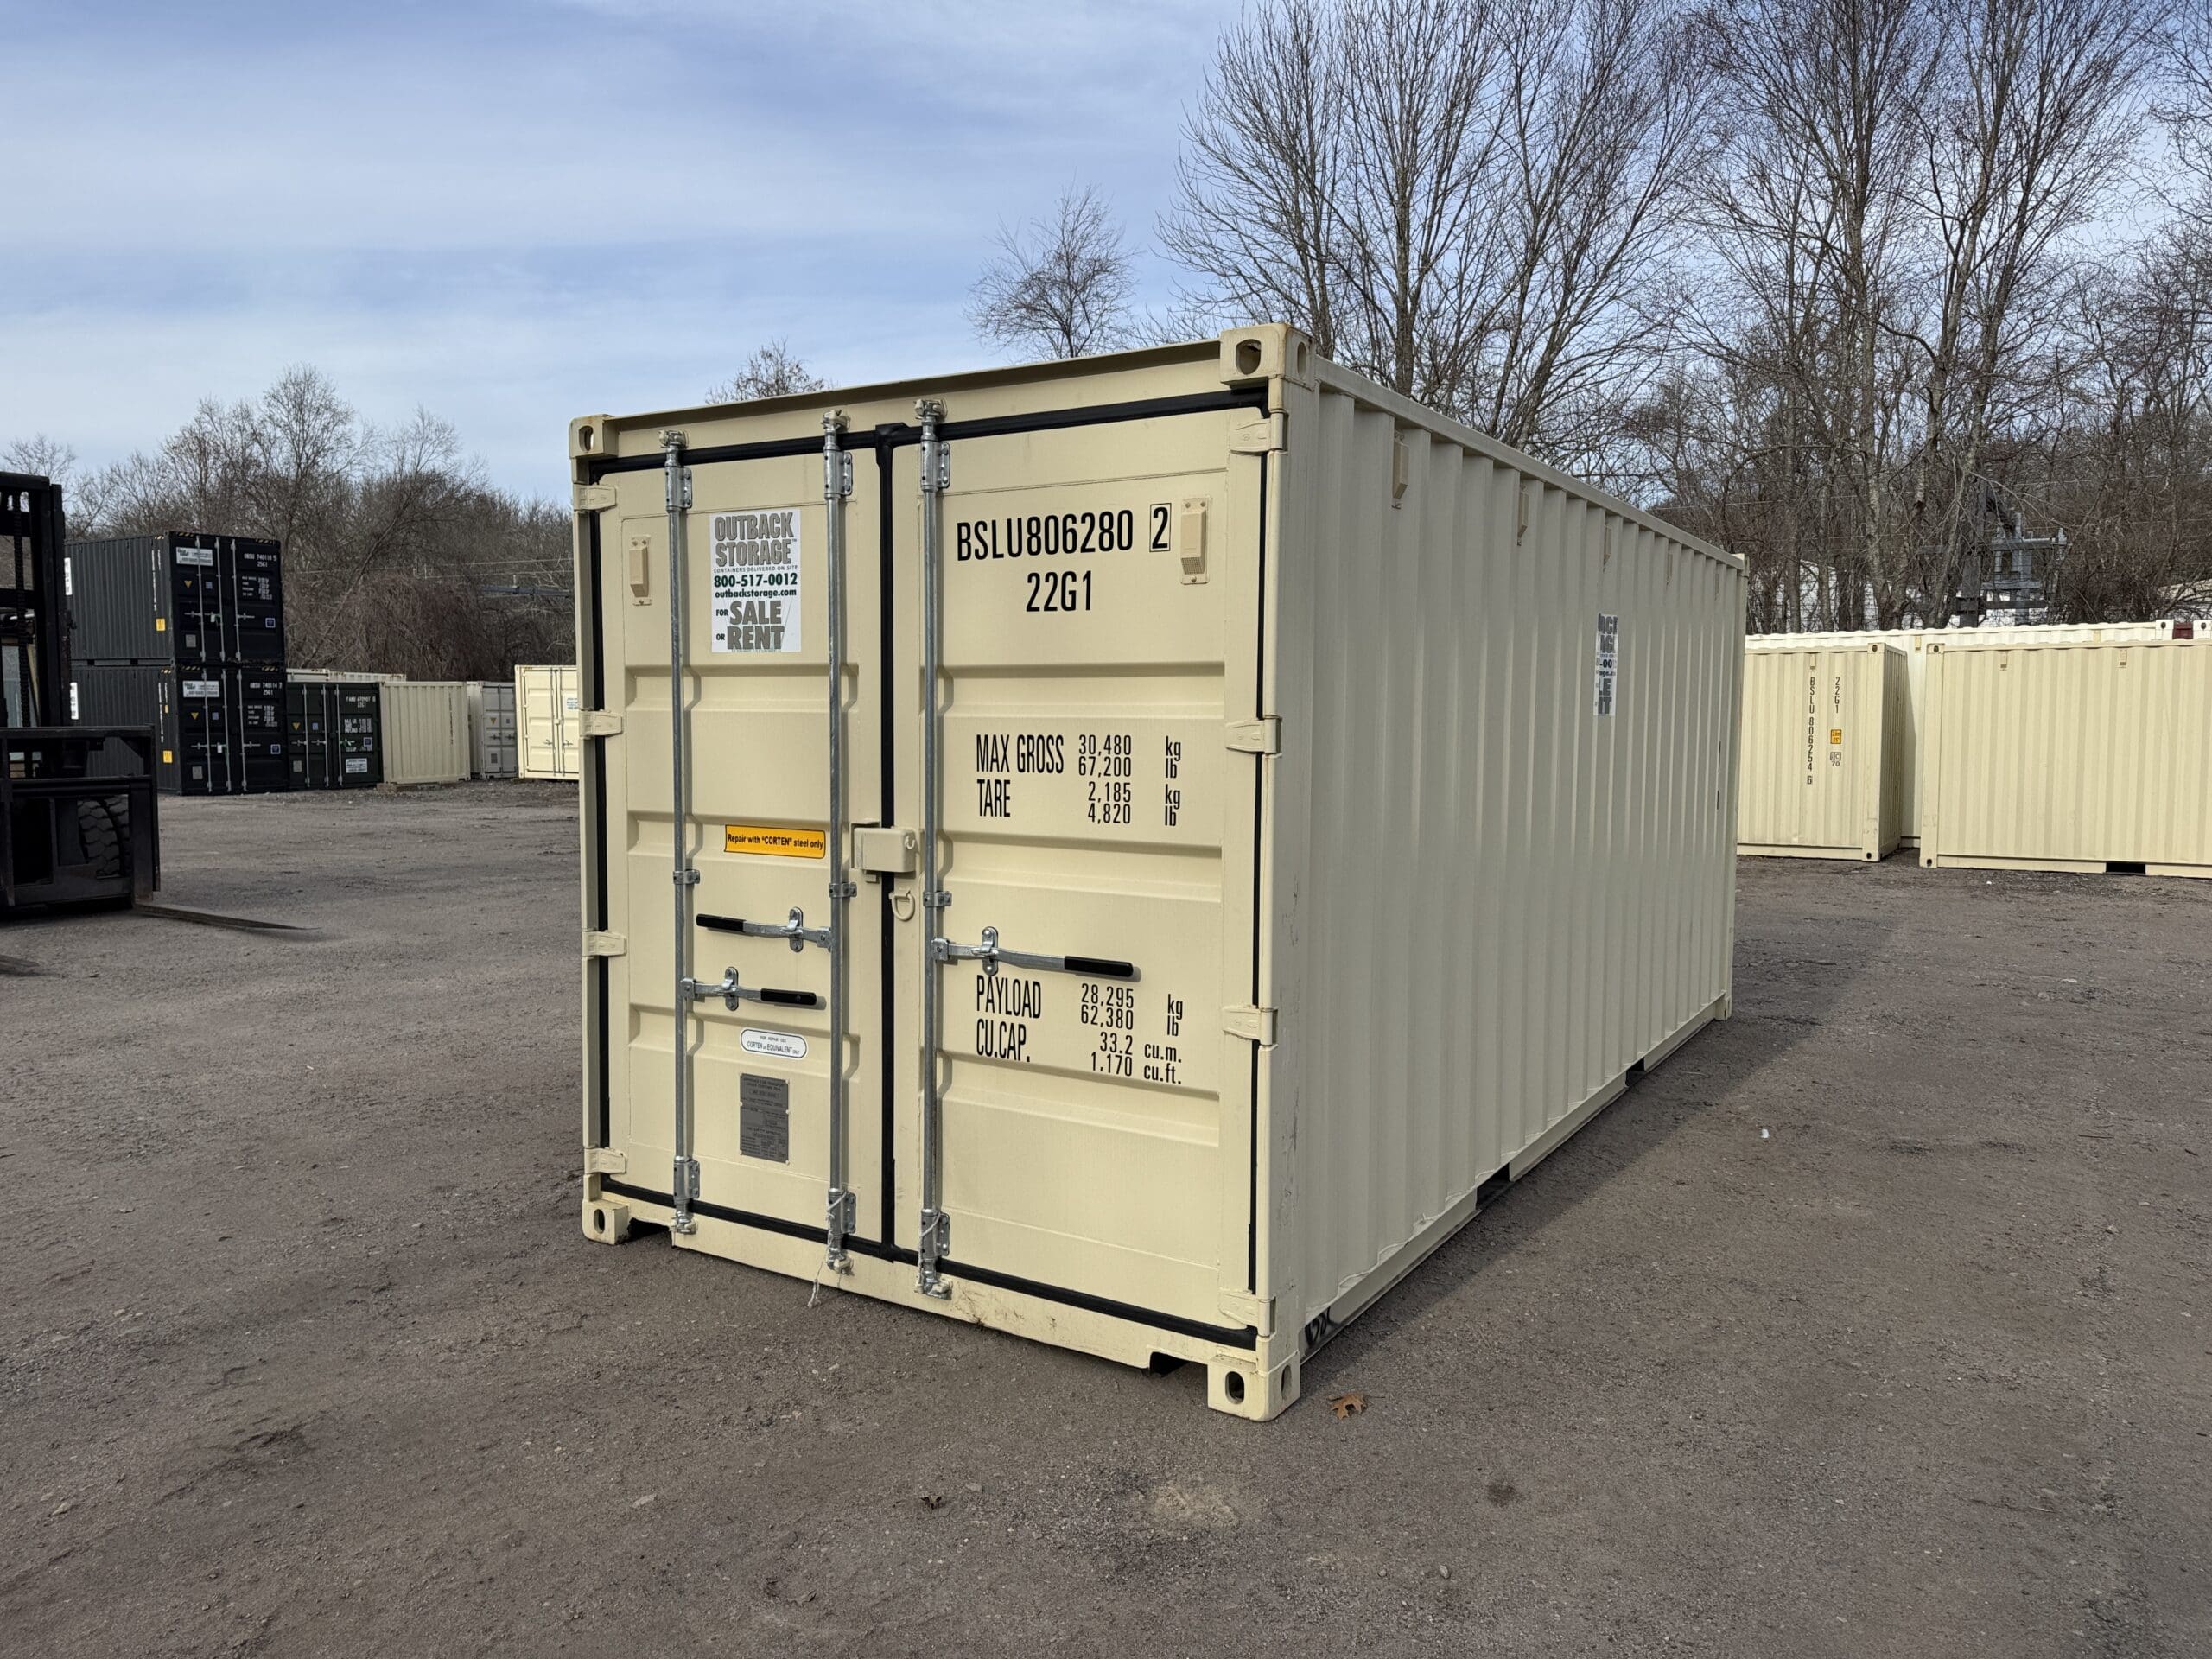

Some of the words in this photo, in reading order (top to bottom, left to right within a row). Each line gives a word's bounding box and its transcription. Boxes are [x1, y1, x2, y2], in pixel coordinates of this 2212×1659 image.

[715, 512, 794, 541] OUTBACK
[957, 510, 1133, 562] BSLU806280
[1153, 507, 1168, 549] 2
[715, 539, 791, 567] STORAGE
[714, 573, 798, 588] 800-517-0012
[715, 588, 797, 598] outbackstorage.com
[1027, 571, 1091, 612] 22G1
[729, 600, 782, 626] SALE
[727, 626, 785, 650] RENT
[976, 734, 1010, 772] MAX
[1017, 734, 1065, 773] GROSS
[1078, 734, 1132, 756] 30,480
[1166, 736, 1181, 762] kg
[1078, 756, 1132, 778] 67,200
[1166, 758, 1177, 779] lb
[977, 779, 1010, 817] TARE
[1088, 781, 1131, 803] 2,185
[1166, 784, 1181, 810] kg
[1088, 803, 1131, 824] 4,820
[1165, 805, 1177, 826] lb
[728, 834, 747, 844] Repair
[793, 838, 809, 848] steel
[810, 840, 823, 850] only
[976, 975, 1041, 1019] PAYLOAD
[1082, 983, 1134, 1008] 28,295
[1168, 994, 1183, 1020] kg
[1081, 1004, 1134, 1030] 62,380
[1167, 1015, 1179, 1036] lb
[766, 1044, 792, 1053] EQUIVALENT
[976, 1019, 1030, 1062] CU.CAP.
[1100, 1032, 1133, 1055] 33.2
[1145, 1044, 1182, 1063] cu.m.
[1091, 1052, 1132, 1077] 1,170
[1144, 1063, 1182, 1084] cu.ft.
